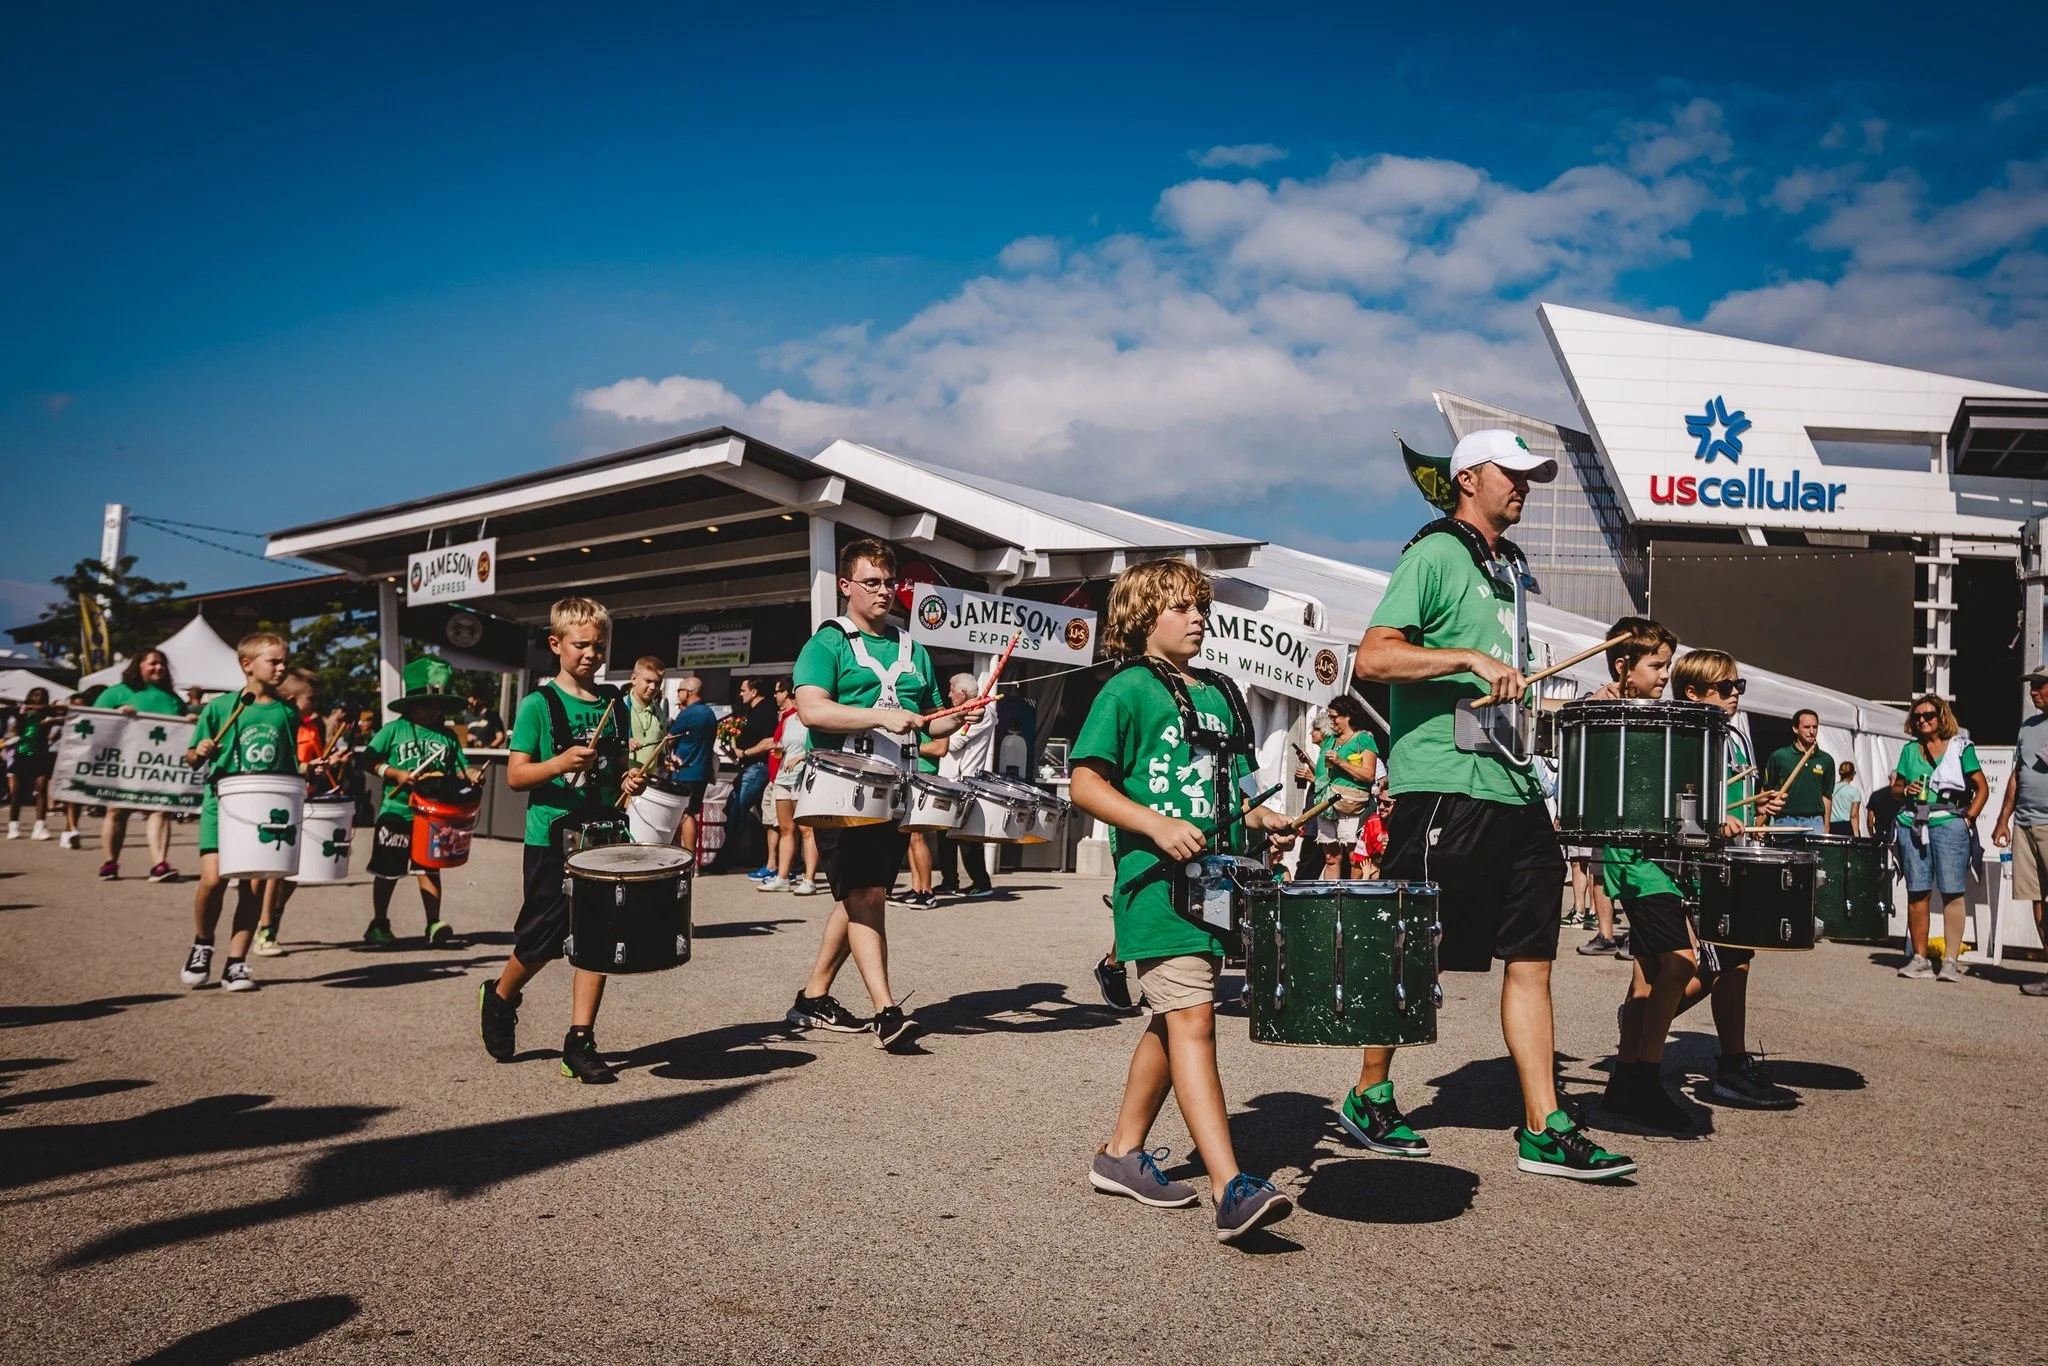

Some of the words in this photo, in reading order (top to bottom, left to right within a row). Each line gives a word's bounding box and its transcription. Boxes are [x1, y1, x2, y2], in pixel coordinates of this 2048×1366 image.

[1650, 467, 1847, 513] uscellular
[423, 552, 474, 587] JAMESON
[432, 581, 466, 596] EXPRESS
[950, 601, 1059, 642] JAMESON
[1203, 614, 1309, 669] AMESON
[1199, 648, 1229, 666] ISH
[1239, 656, 1315, 692] WHISKEY
[137, 751, 190, 769] DALE
